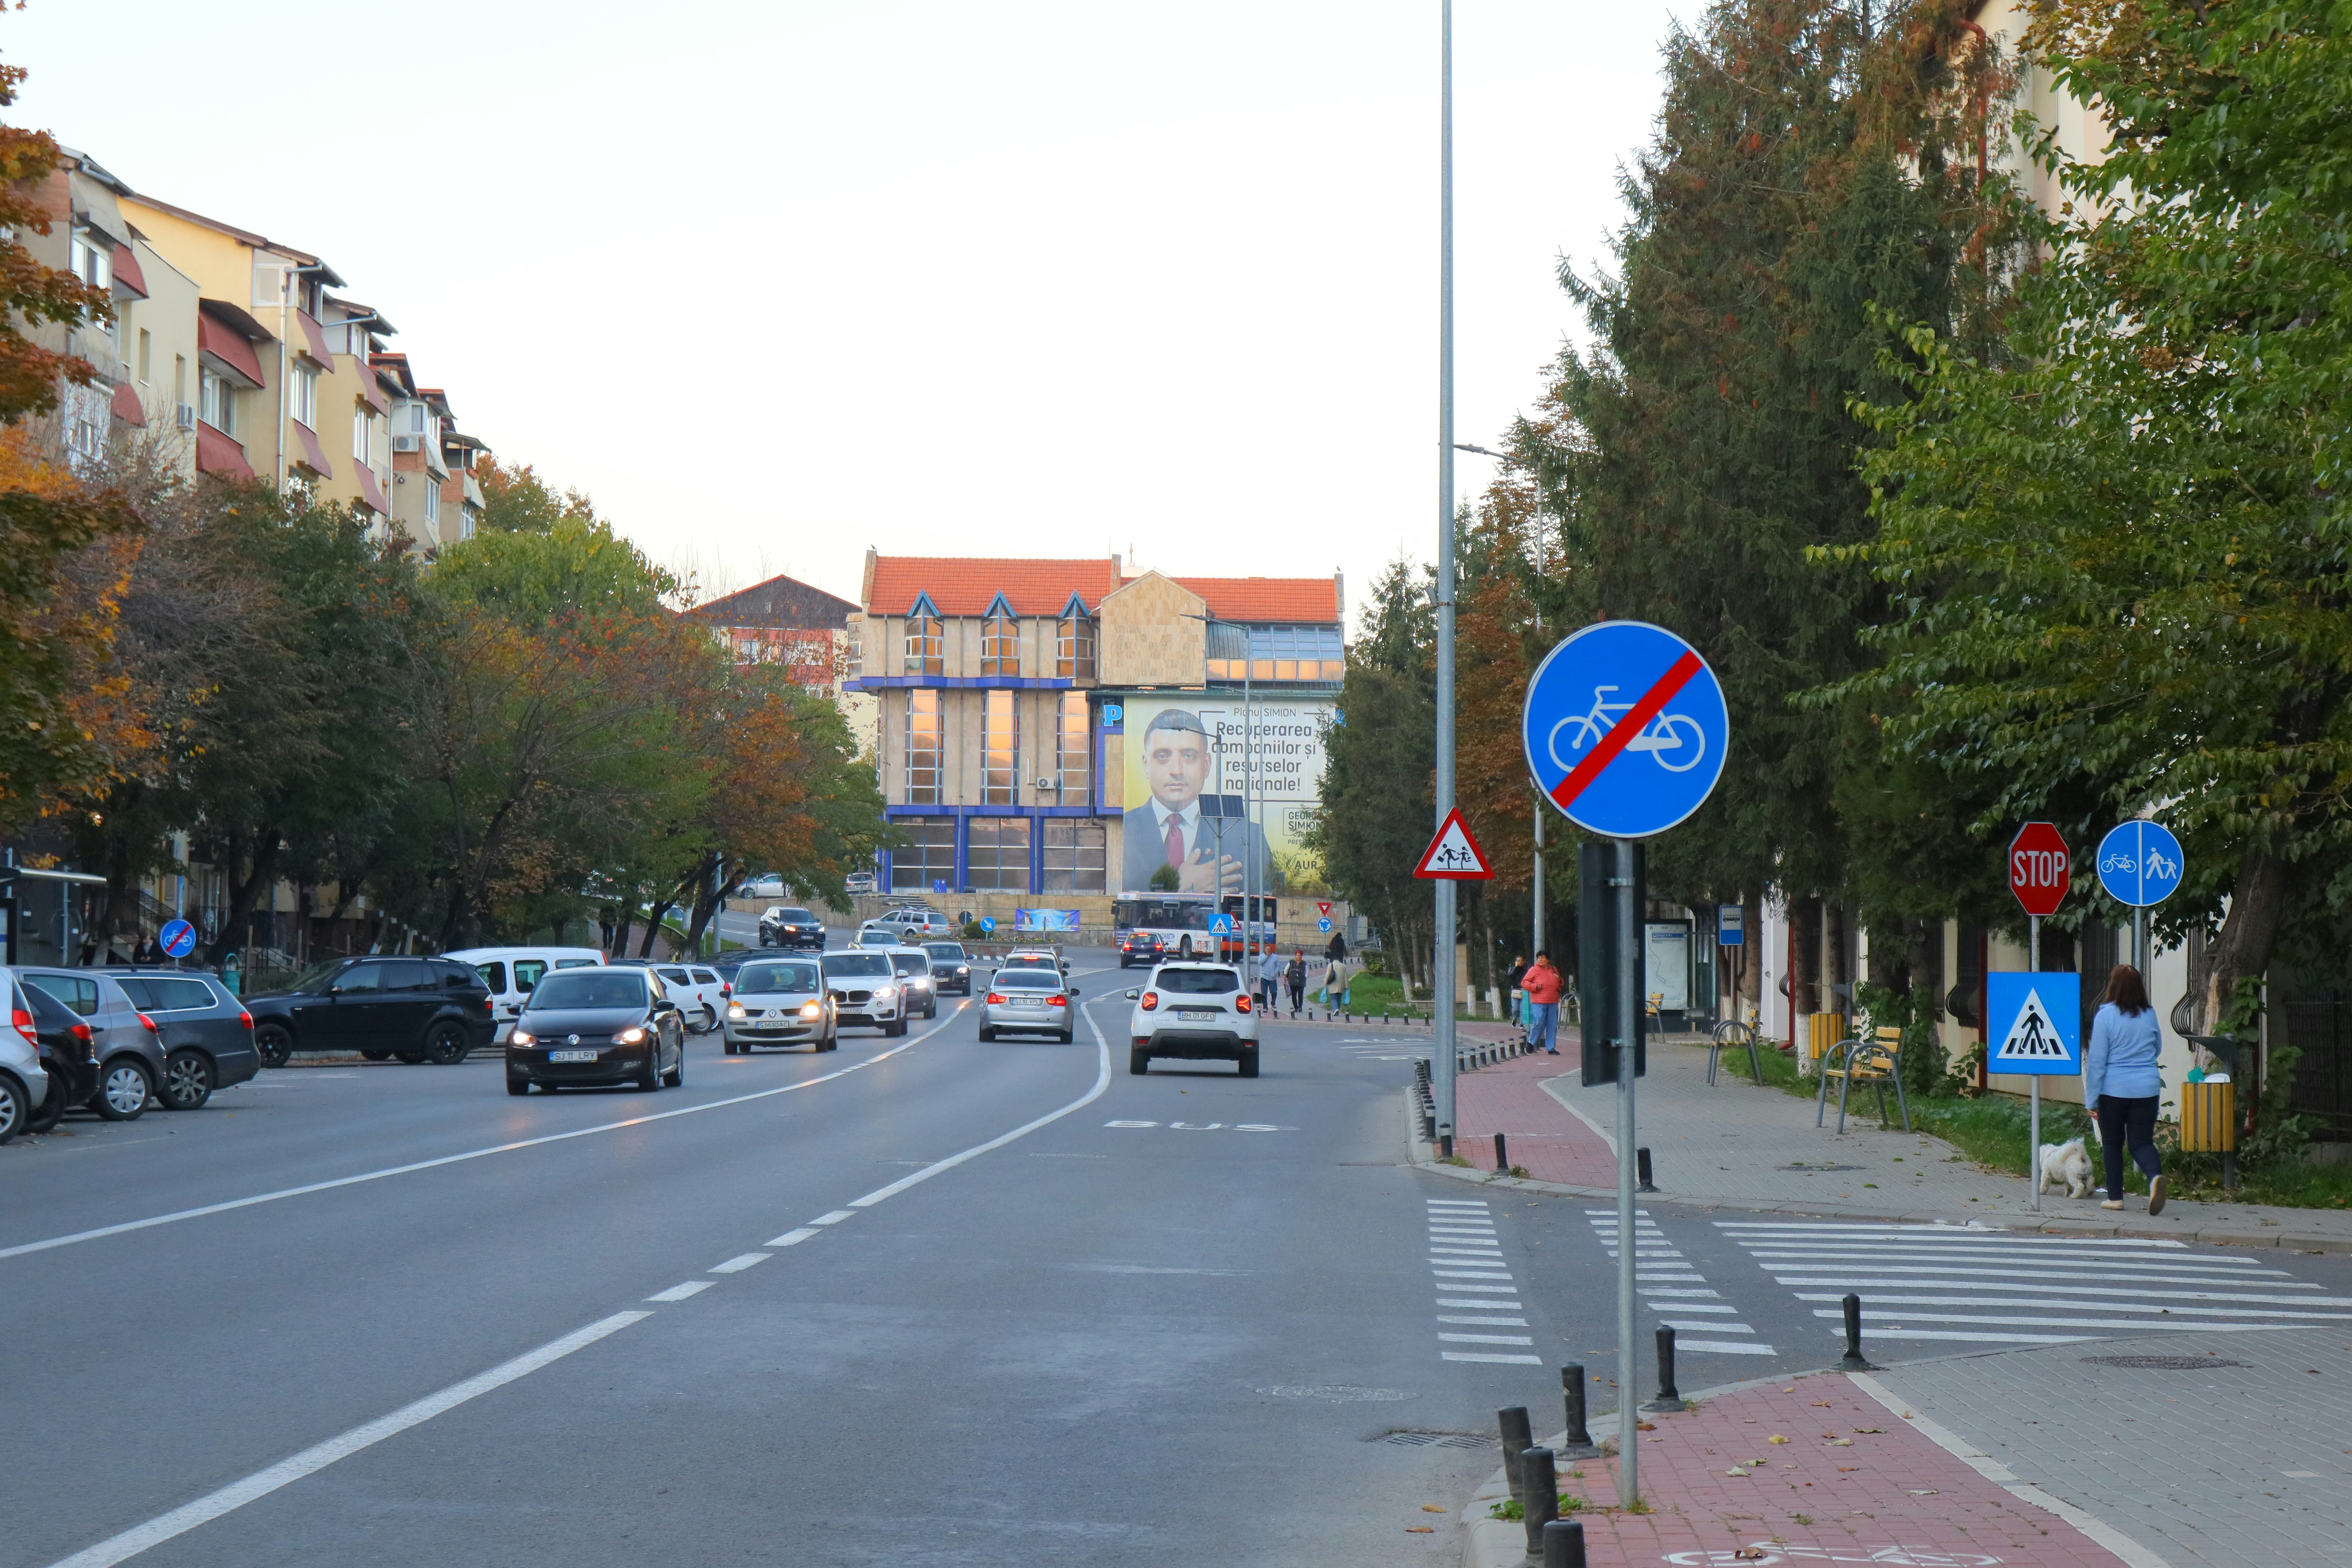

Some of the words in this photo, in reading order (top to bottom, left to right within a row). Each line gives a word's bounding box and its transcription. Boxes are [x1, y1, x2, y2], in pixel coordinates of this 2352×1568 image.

[1104, 705, 1122, 726] P
[1234, 707, 1259, 717] Planu
[1264, 708, 1296, 717] SIMION
[1217, 721, 1312, 739] Recuperarea
[1226, 776, 1301, 791] naionale!
[1294, 860, 1318, 869] AUR
[2014, 850, 2066, 887] STOP
[1102, 1120, 1280, 1132] BUS
